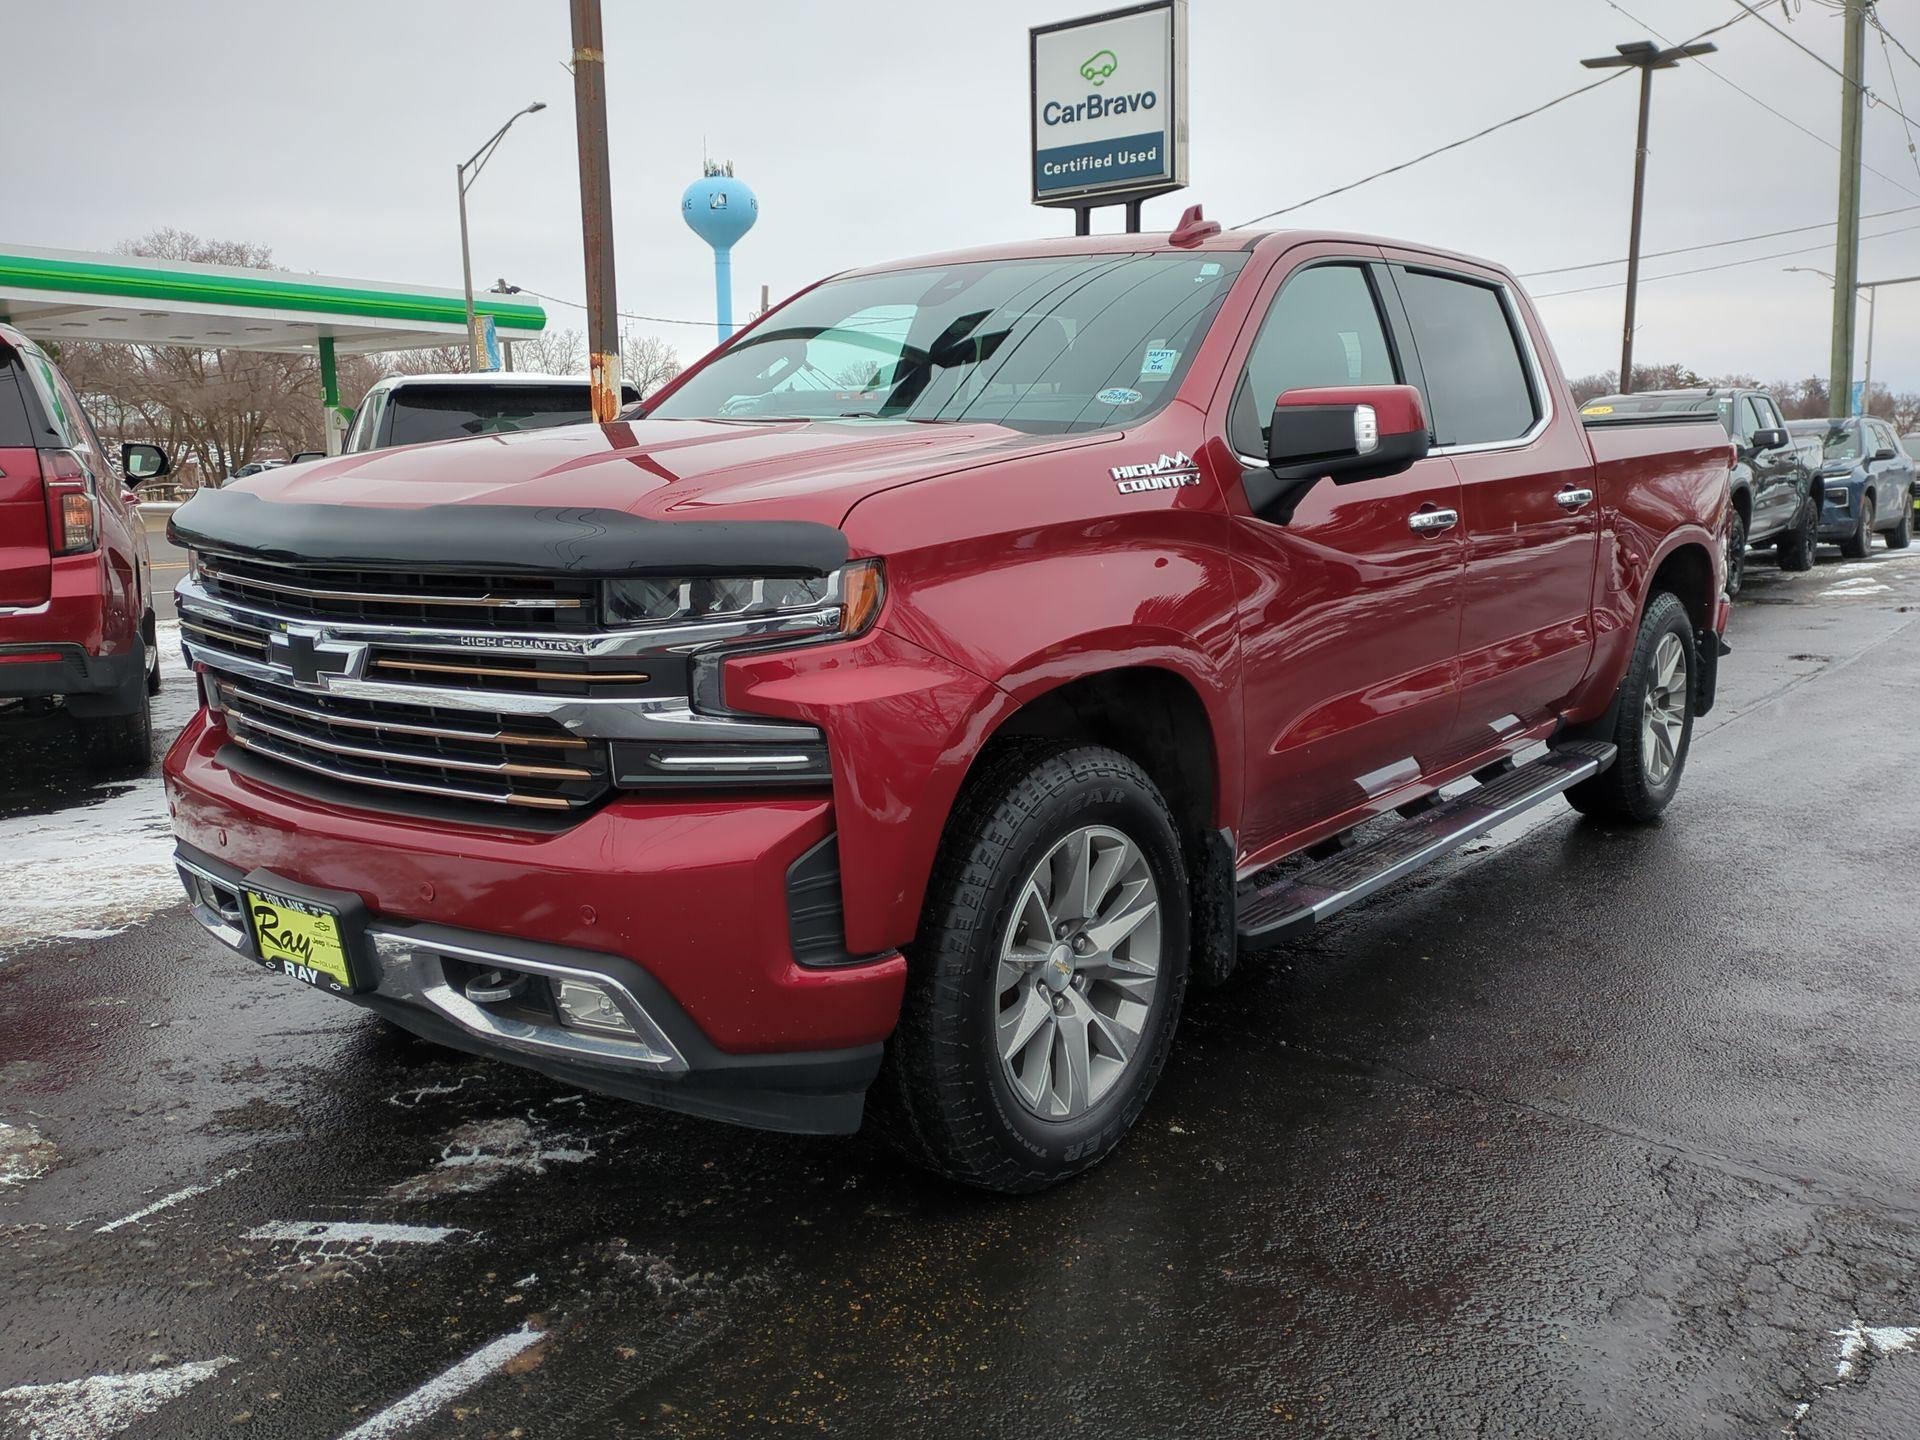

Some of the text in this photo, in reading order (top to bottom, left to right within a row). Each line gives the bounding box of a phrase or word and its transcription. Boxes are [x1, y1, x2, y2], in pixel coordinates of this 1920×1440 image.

[1043, 90, 1157, 126] CarBravo
[1043, 147, 1157, 176] Certified Used
[1111, 463, 1159, 480] HIGH
[1118, 473, 1201, 494] COUNTRY
[460, 636, 580, 653] HIGH COUNTRY
[263, 892, 307, 914] FOX LAKE
[254, 905, 314, 966] Ray
[283, 960, 317, 984] RAY
